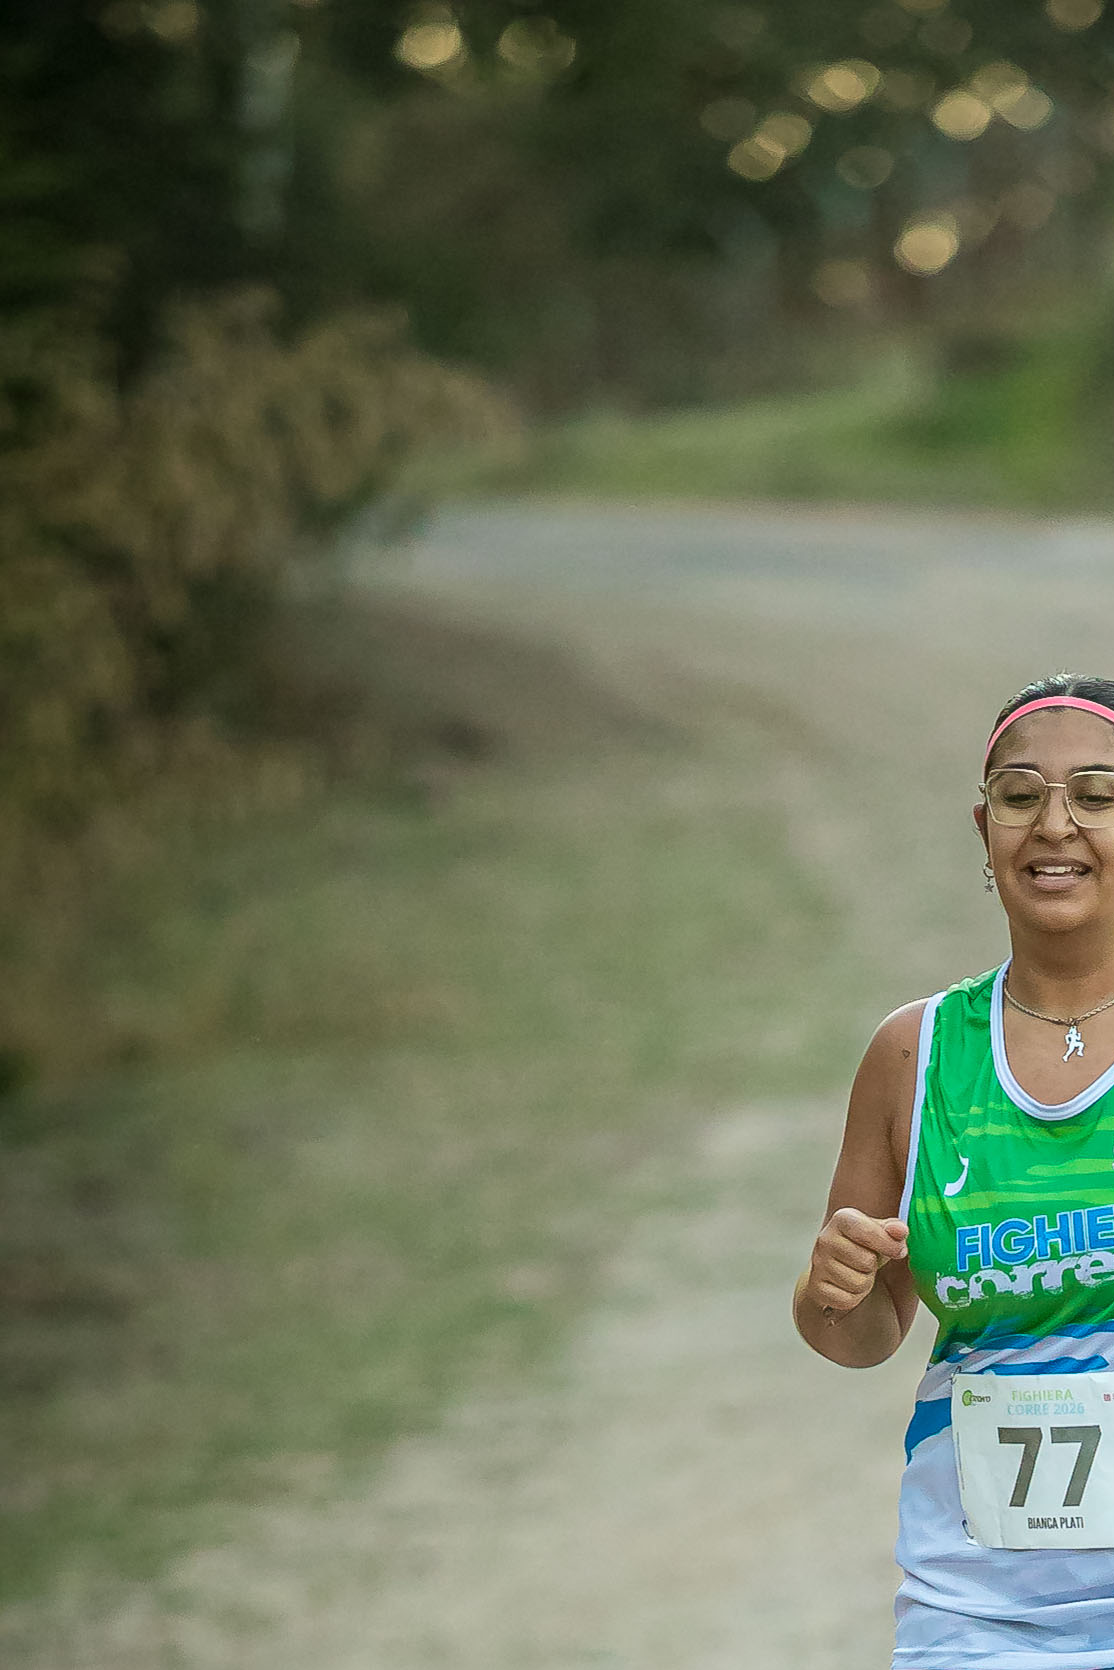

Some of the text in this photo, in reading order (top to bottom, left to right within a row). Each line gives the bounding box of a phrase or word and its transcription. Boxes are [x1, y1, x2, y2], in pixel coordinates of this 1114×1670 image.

[1011, 1389, 1073, 1401] FIGHIERA
[1007, 1402, 1085, 1415] CORRE 2026
[997, 1424, 1102, 1507] 77
[1027, 1516, 1085, 1529] BIANCA PLATI
